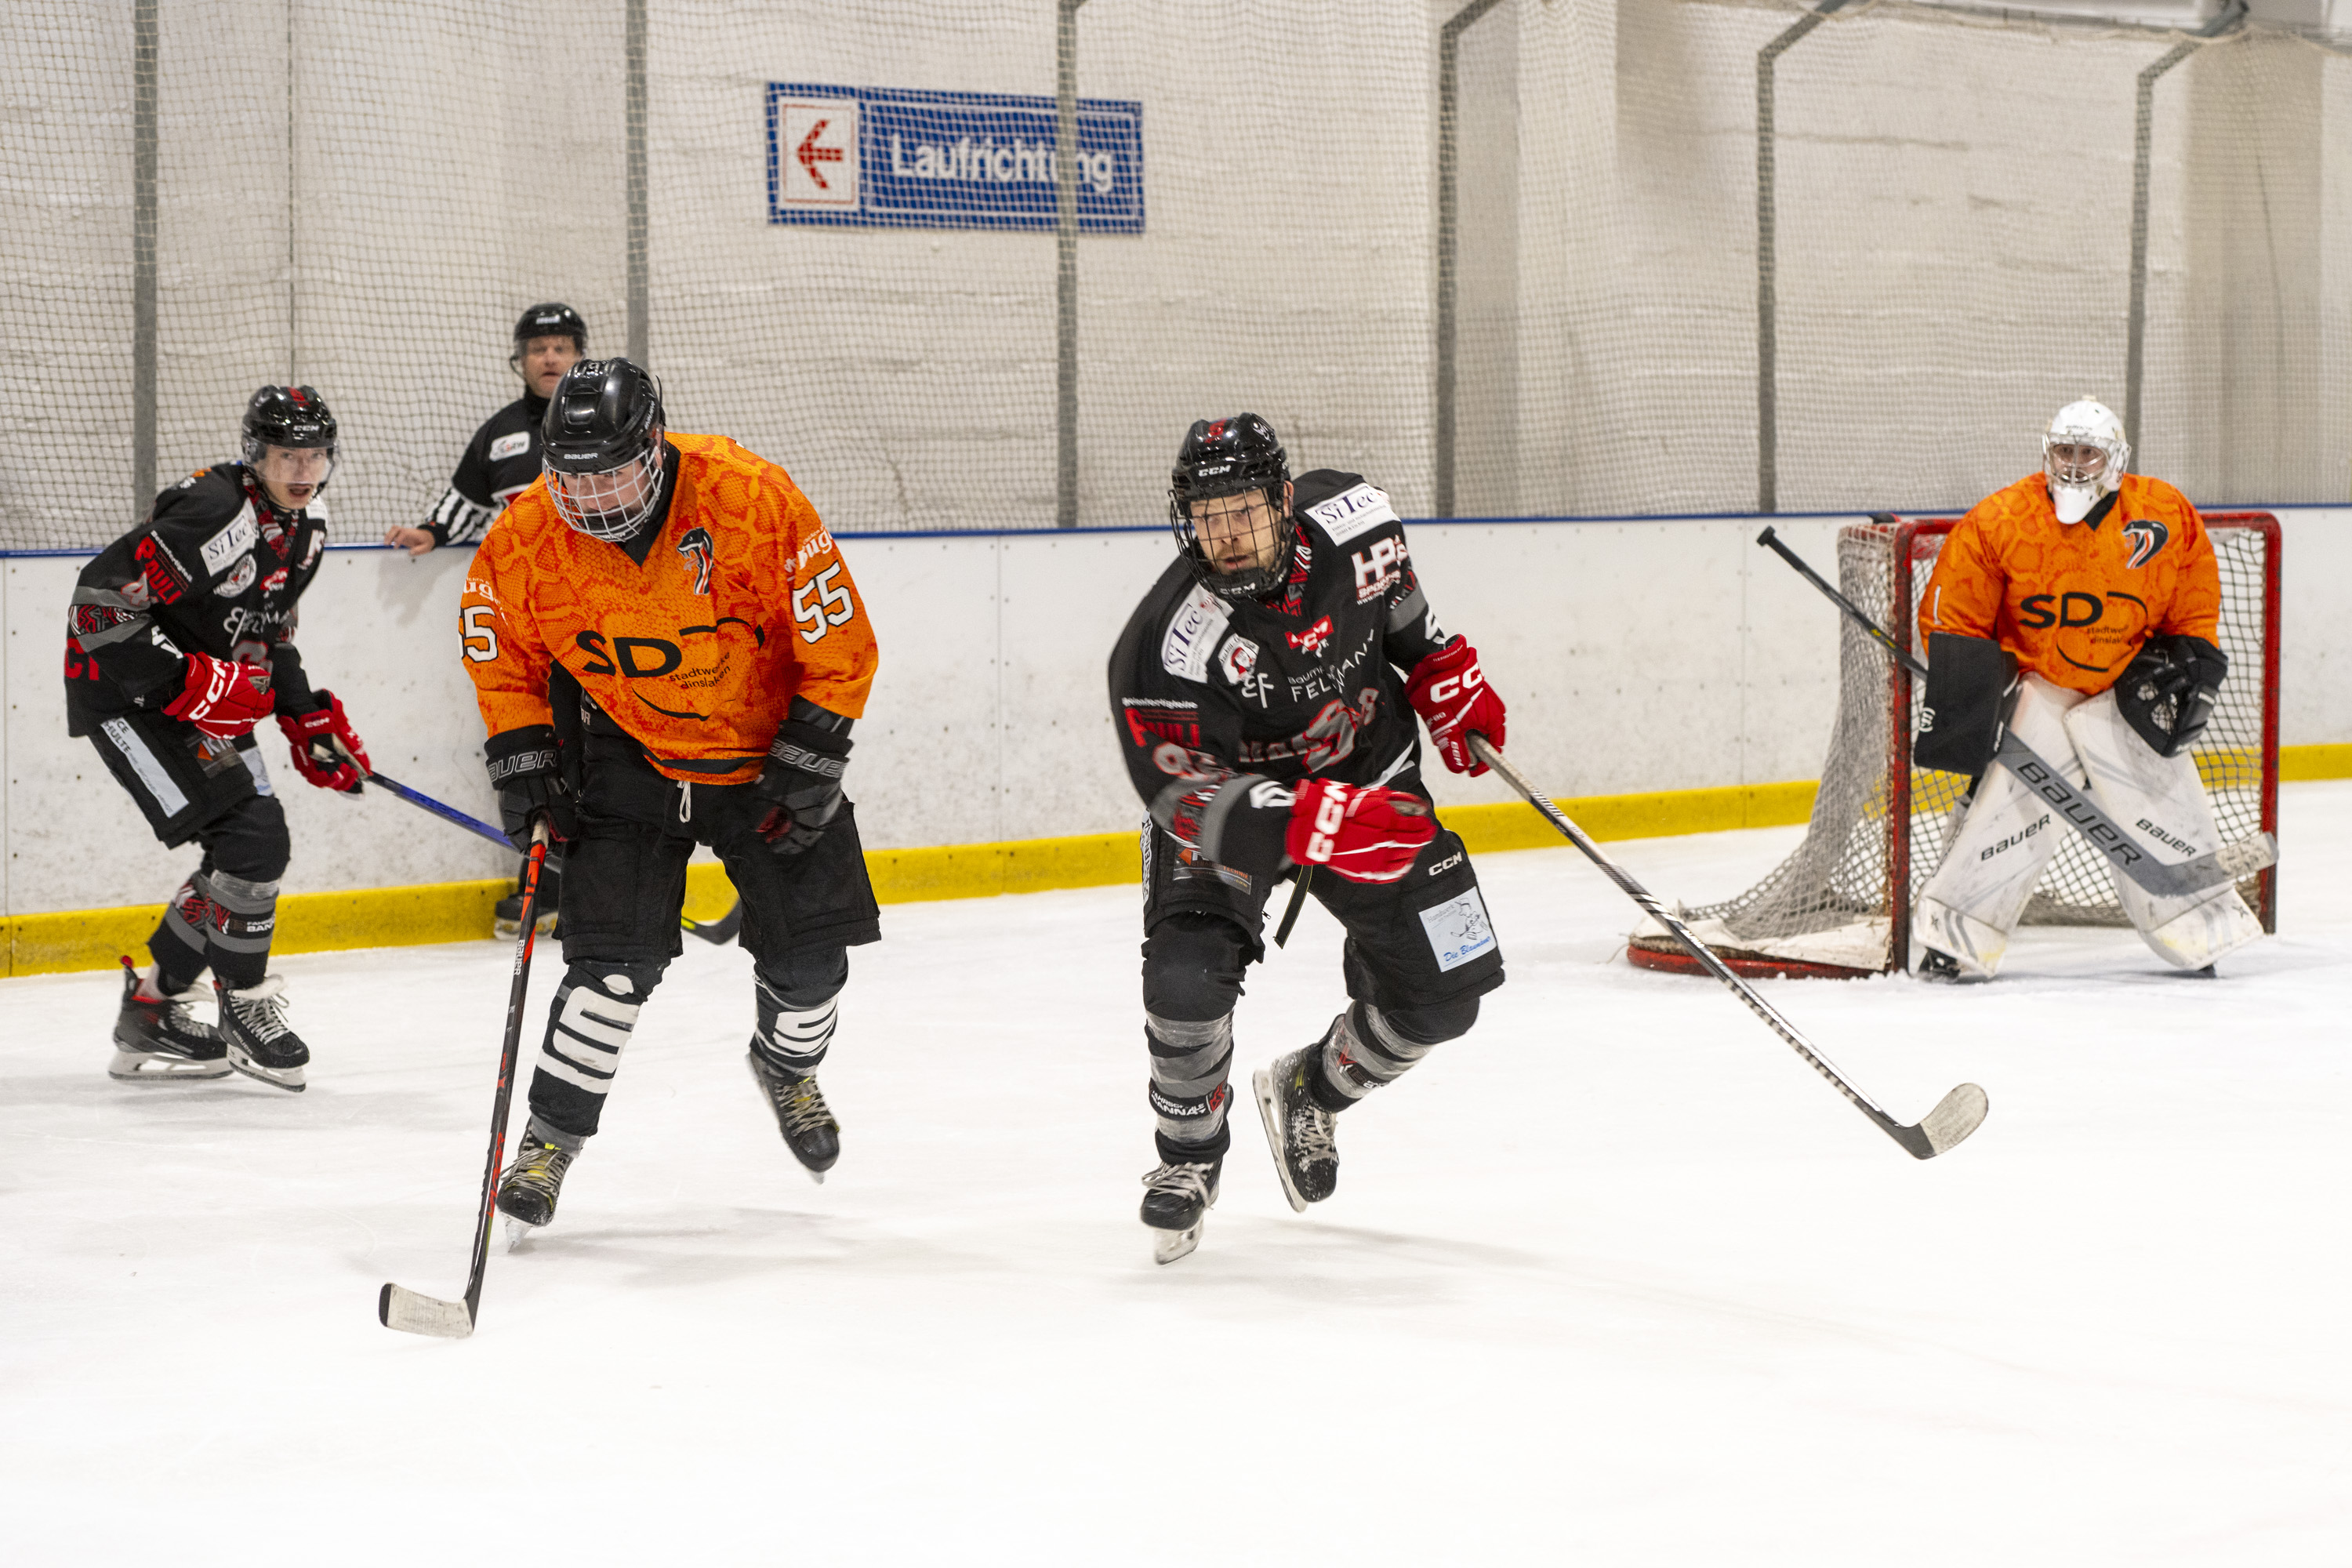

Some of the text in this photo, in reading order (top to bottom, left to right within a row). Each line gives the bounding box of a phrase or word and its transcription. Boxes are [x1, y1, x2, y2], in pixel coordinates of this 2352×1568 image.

[1198, 464, 1232, 477] CCM
[792, 558, 855, 645] 55
[2018, 591, 2104, 630] SD
[458, 604, 499, 664] 5
[575, 630, 683, 679] SD
[669, 652, 731, 683] stadtwerke
[680, 665, 731, 690] dinslaken
[1430, 662, 1486, 704] CC
[488, 750, 557, 784] AUER
[768, 738, 850, 779] BAUE
[2016, 761, 2143, 866] BAUER
[1980, 813, 2053, 862] BAUER
[2134, 818, 2198, 858] BAUER
[1428, 851, 1464, 877] CCM
[513, 938, 526, 977] BAUER
[1443, 951, 1459, 962] Die
